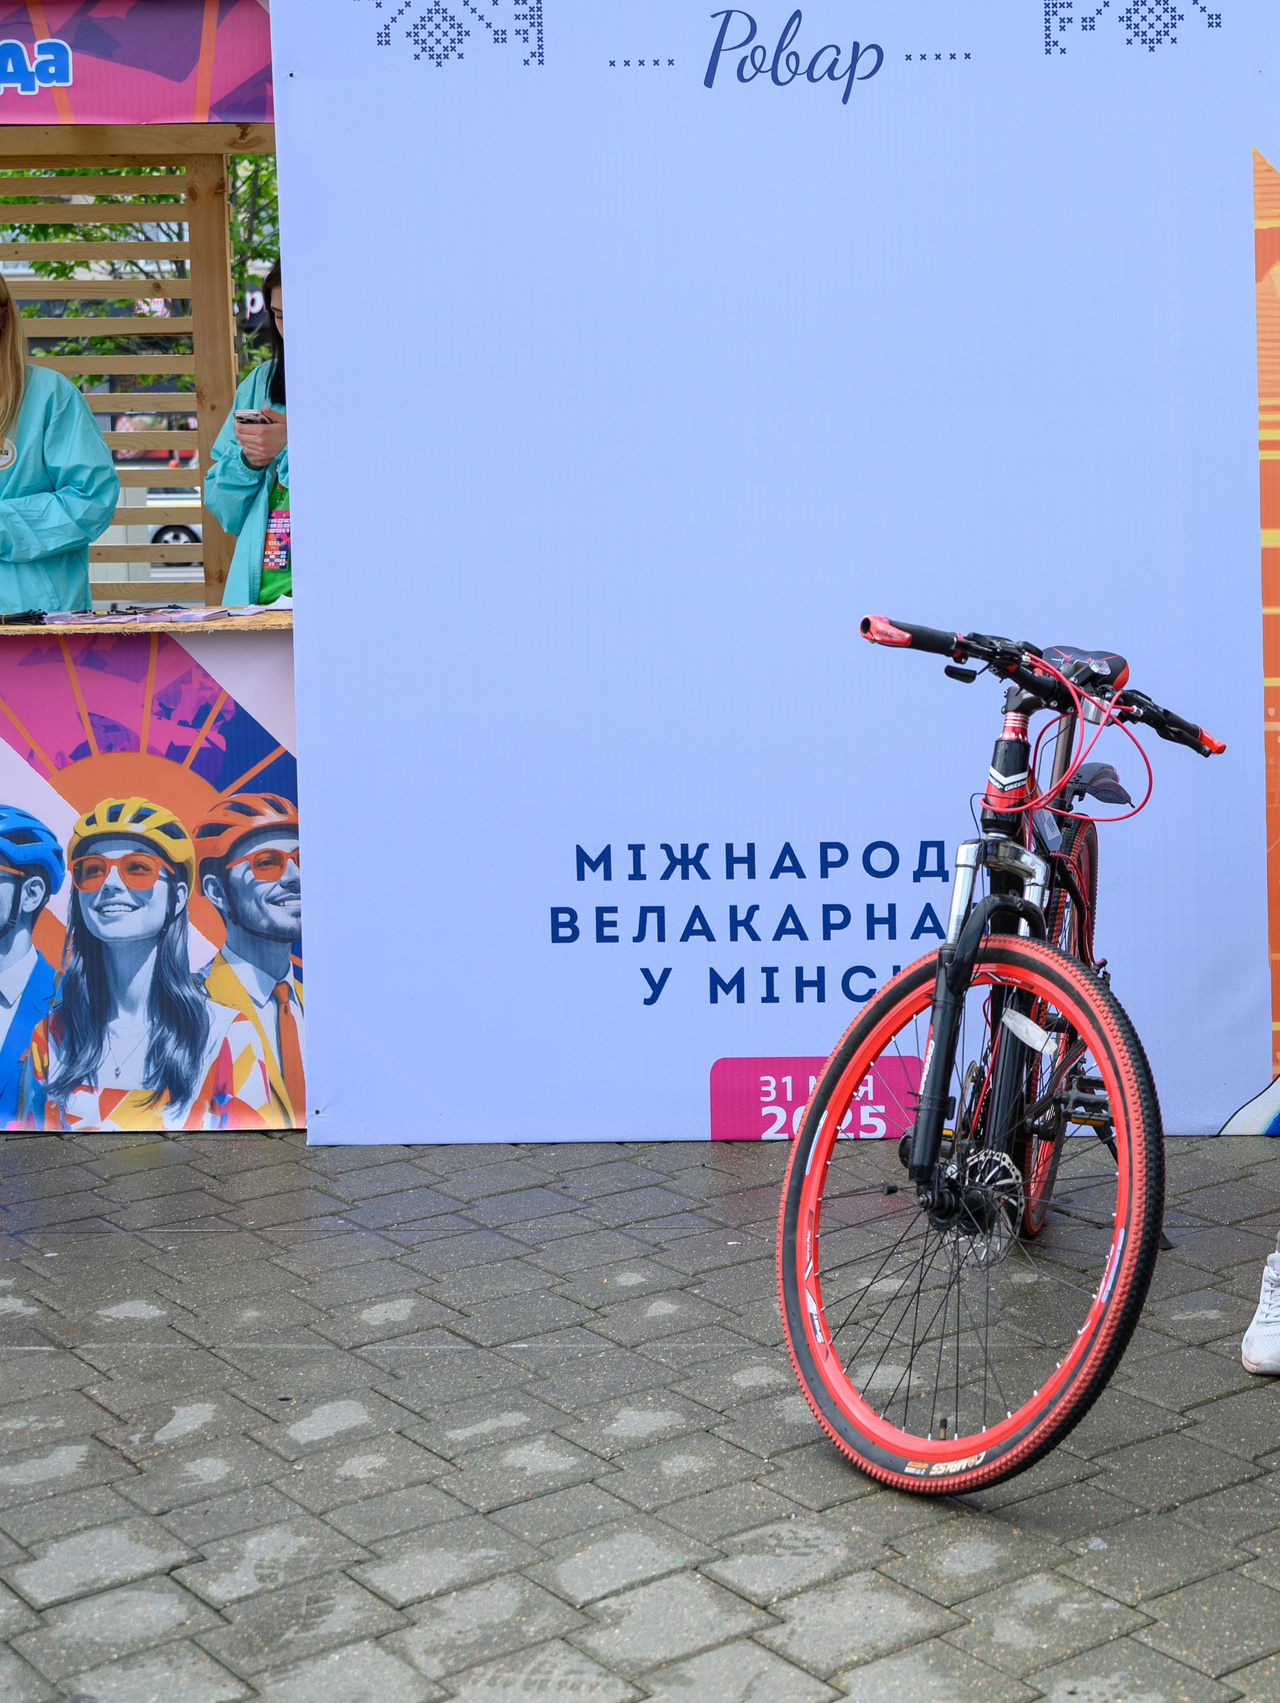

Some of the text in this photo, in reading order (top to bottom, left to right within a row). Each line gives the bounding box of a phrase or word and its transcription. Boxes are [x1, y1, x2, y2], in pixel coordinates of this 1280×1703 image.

[704, 9, 884, 105] Ровар
[575, 840, 991, 883] МІЖНАРОД
[709, 965, 903, 1005] МІНС
[759, 1075, 792, 1102] 31
[929, 1451, 986, 1475] COMPASS
